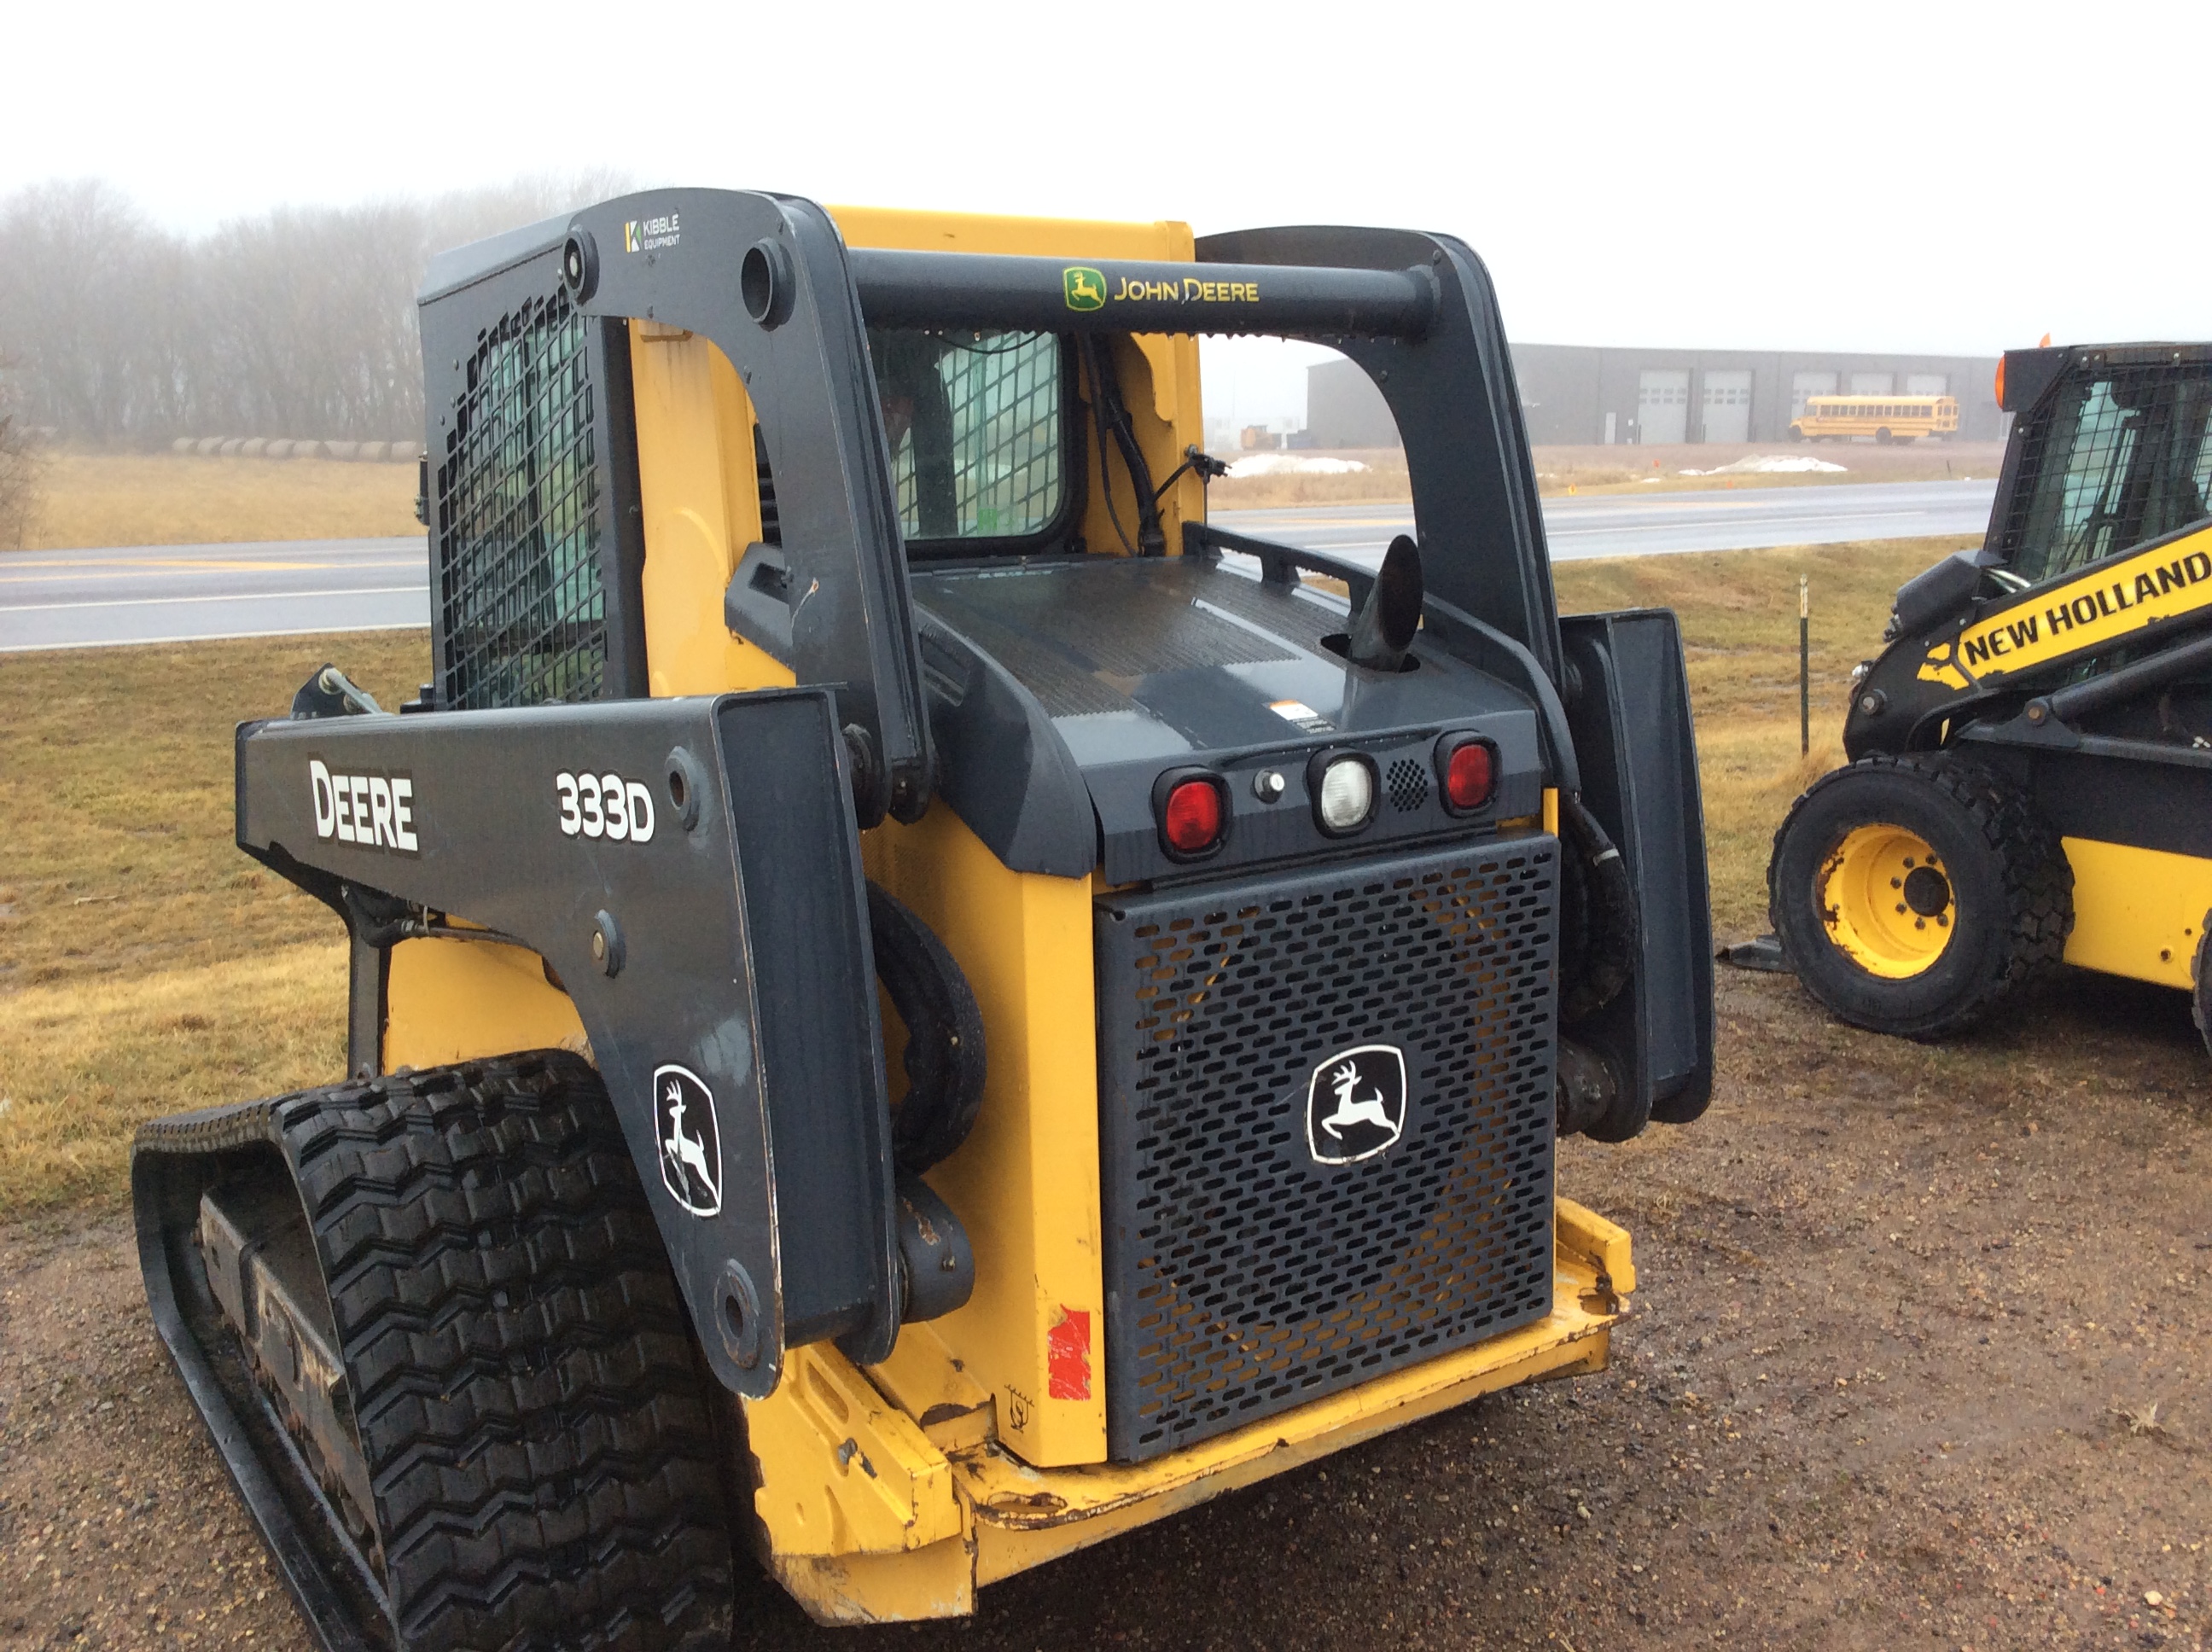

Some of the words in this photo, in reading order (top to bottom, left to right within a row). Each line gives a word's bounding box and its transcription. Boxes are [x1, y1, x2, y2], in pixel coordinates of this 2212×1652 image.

[643, 213, 680, 236] KIBBLE
[643, 234, 680, 250] EQUIPMENT
[1114, 276, 1179, 301] JOHN
[1183, 277, 1260, 302] DEERE
[1964, 614, 2039, 666] NEW
[2045, 550, 2212, 637] HOLLAND
[309, 759, 419, 852] DEERE
[556, 772, 655, 842] 333D
